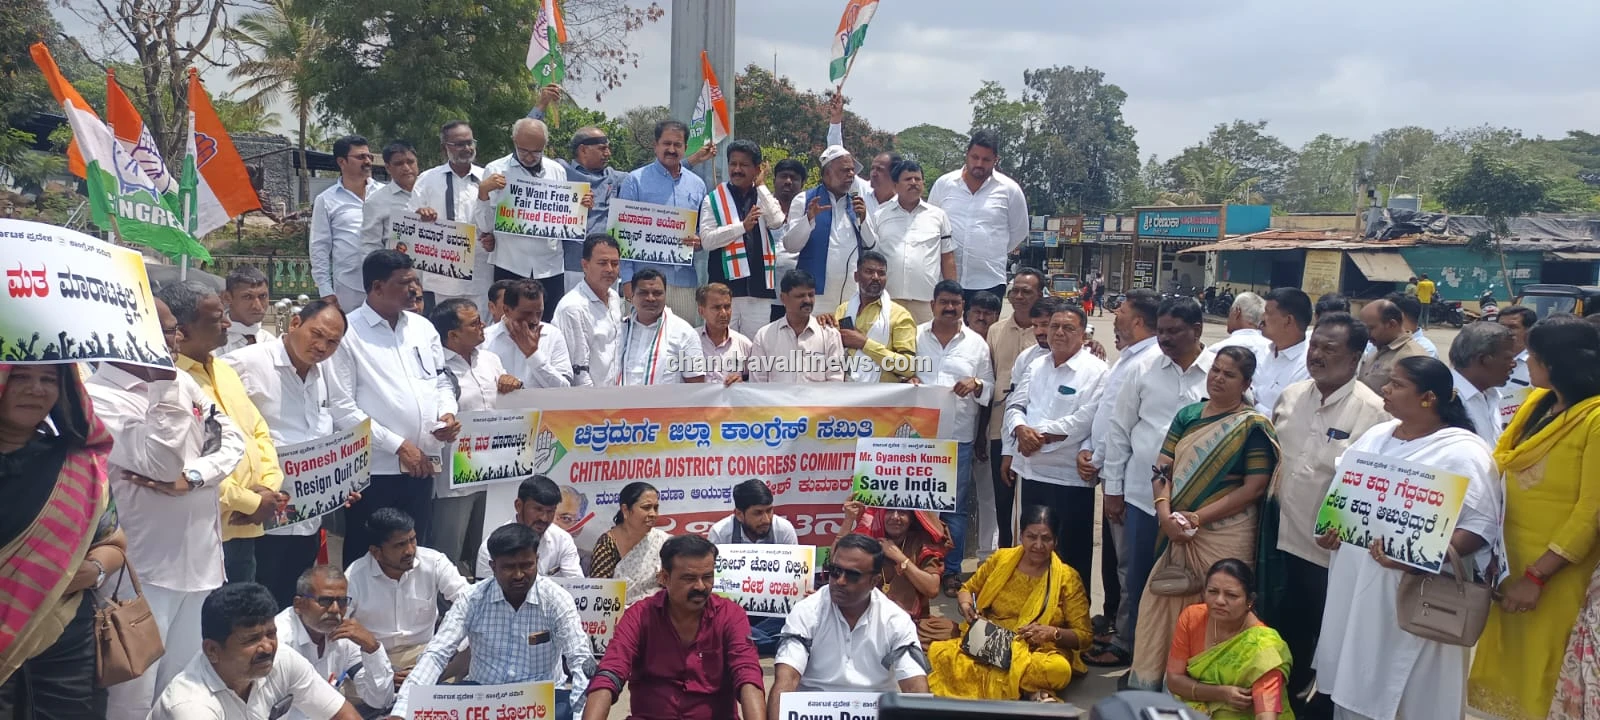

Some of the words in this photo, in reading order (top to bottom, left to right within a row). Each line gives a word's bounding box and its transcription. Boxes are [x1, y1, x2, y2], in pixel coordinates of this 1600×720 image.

[510, 183, 523, 197] We
[525, 187, 548, 199] Want
[550, 190, 570, 202] Free
[572, 192, 579, 203] &
[514, 196, 531, 209] Fair
[534, 200, 572, 214] Election,
[500, 206, 515, 218] Not
[517, 209, 541, 222] Fixed
[543, 213, 578, 225] Election
[6, 260, 50, 298] ಮತ
[574, 418, 660, 453] ಚಿತ್ರದುರ್ಗ
[668, 421, 712, 448] ಜಿಲ್ಲಾ
[720, 416, 808, 448] ಕಾಂಗ್ರೆಸ್
[817, 416, 874, 439] ಸಮಿತಿ
[284, 450, 337, 477] Gyanesh
[341, 435, 369, 460] Kumar
[859, 452, 873, 462] Mr.
[876, 451, 917, 464] Gyanesh
[920, 453, 952, 464] Kumar
[294, 475, 332, 498] Resign
[334, 462, 352, 485] Quit
[354, 451, 369, 474] CEC
[570, 457, 661, 484] CHITRADURGA
[664, 455, 724, 478] DISTRICT
[727, 454, 797, 477] CONGRESS
[800, 451, 856, 473] COMMITT
[875, 465, 901, 476] Quit
[906, 466, 933, 477] CEC
[860, 475, 899, 491] Save
[905, 477, 947, 492] India
[1342, 470, 1364, 486] ಮತ
[742, 576, 764, 593] ದೇಶ
[466, 706, 490, 720] CEC
